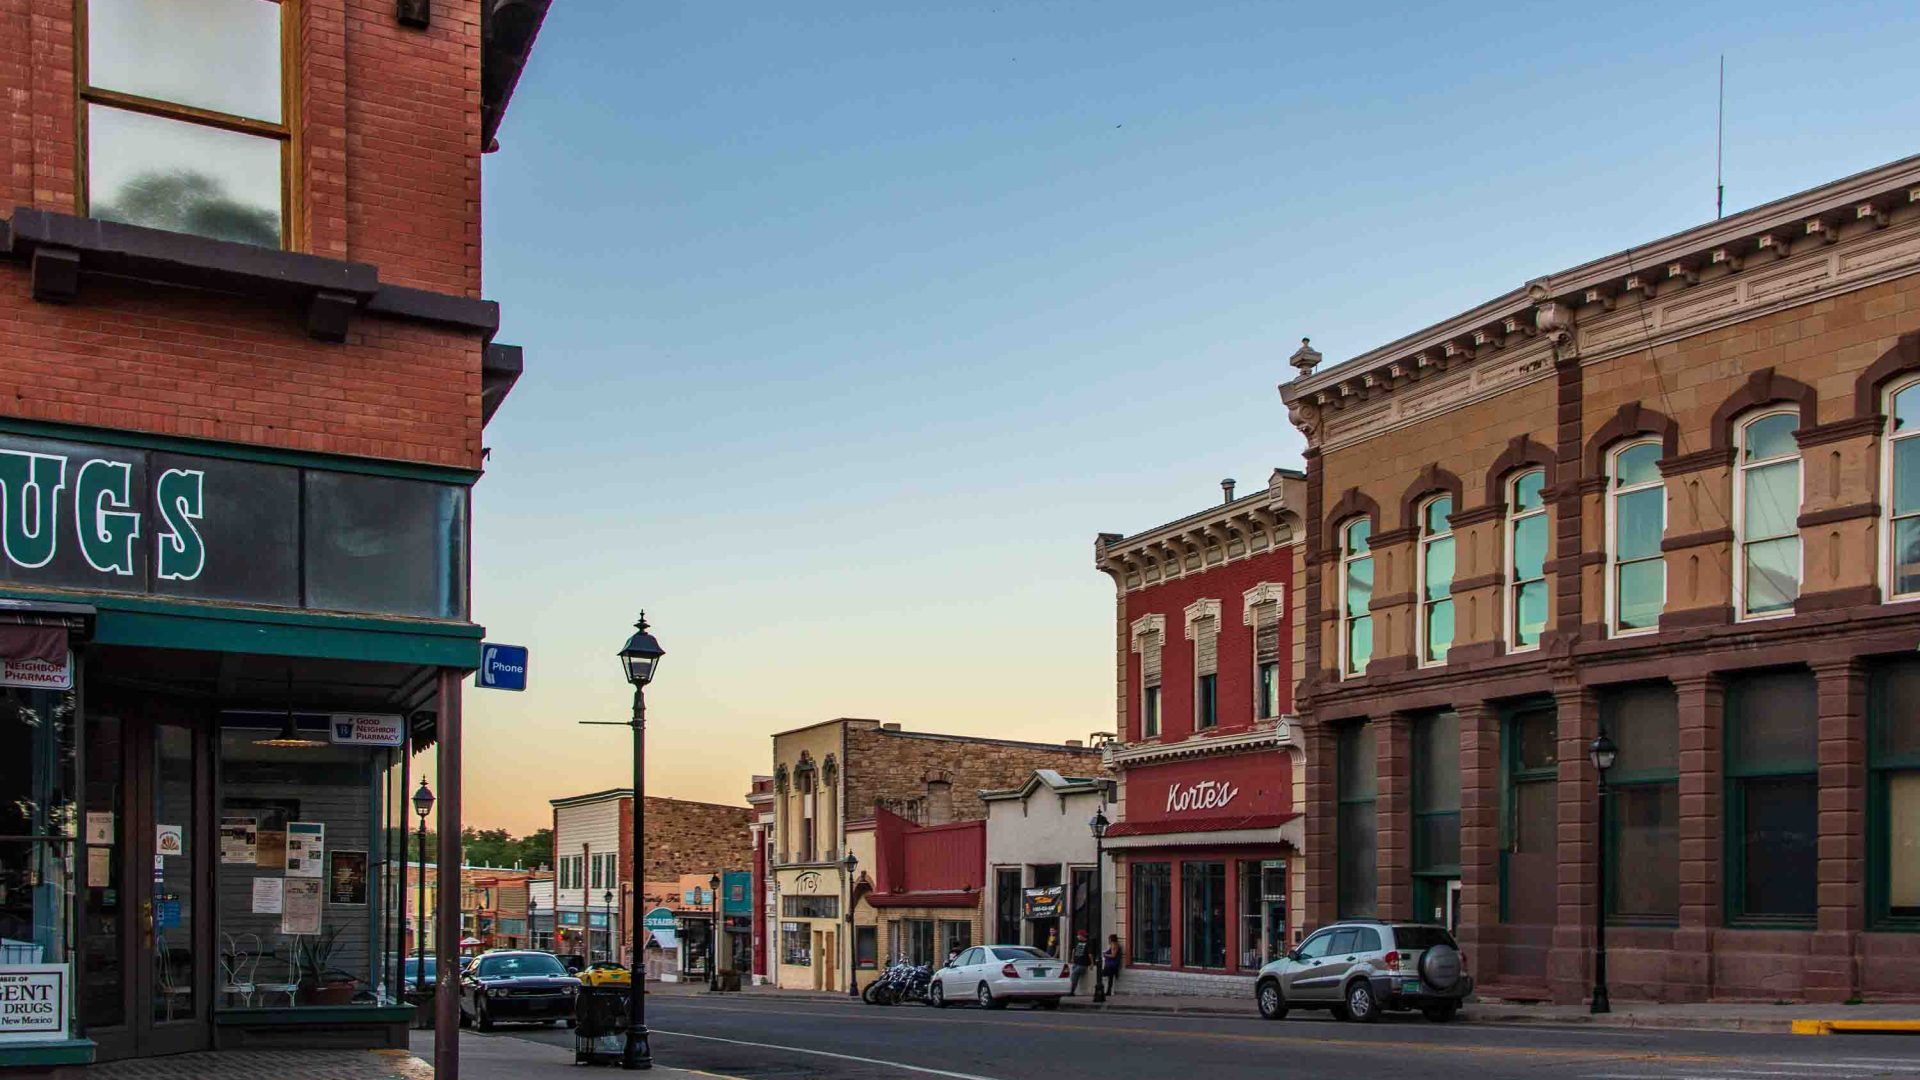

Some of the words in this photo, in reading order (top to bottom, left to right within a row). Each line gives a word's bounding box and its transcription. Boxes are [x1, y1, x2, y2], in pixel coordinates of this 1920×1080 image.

[492, 661, 524, 673] Phone
[4, 670, 67, 683] PHARMACY
[1166, 780, 1239, 813] Korte's
[4, 1003, 53, 1014] DRUGS
[2, 1017, 20, 1025] New
[22, 1016, 53, 1025] Mexico
